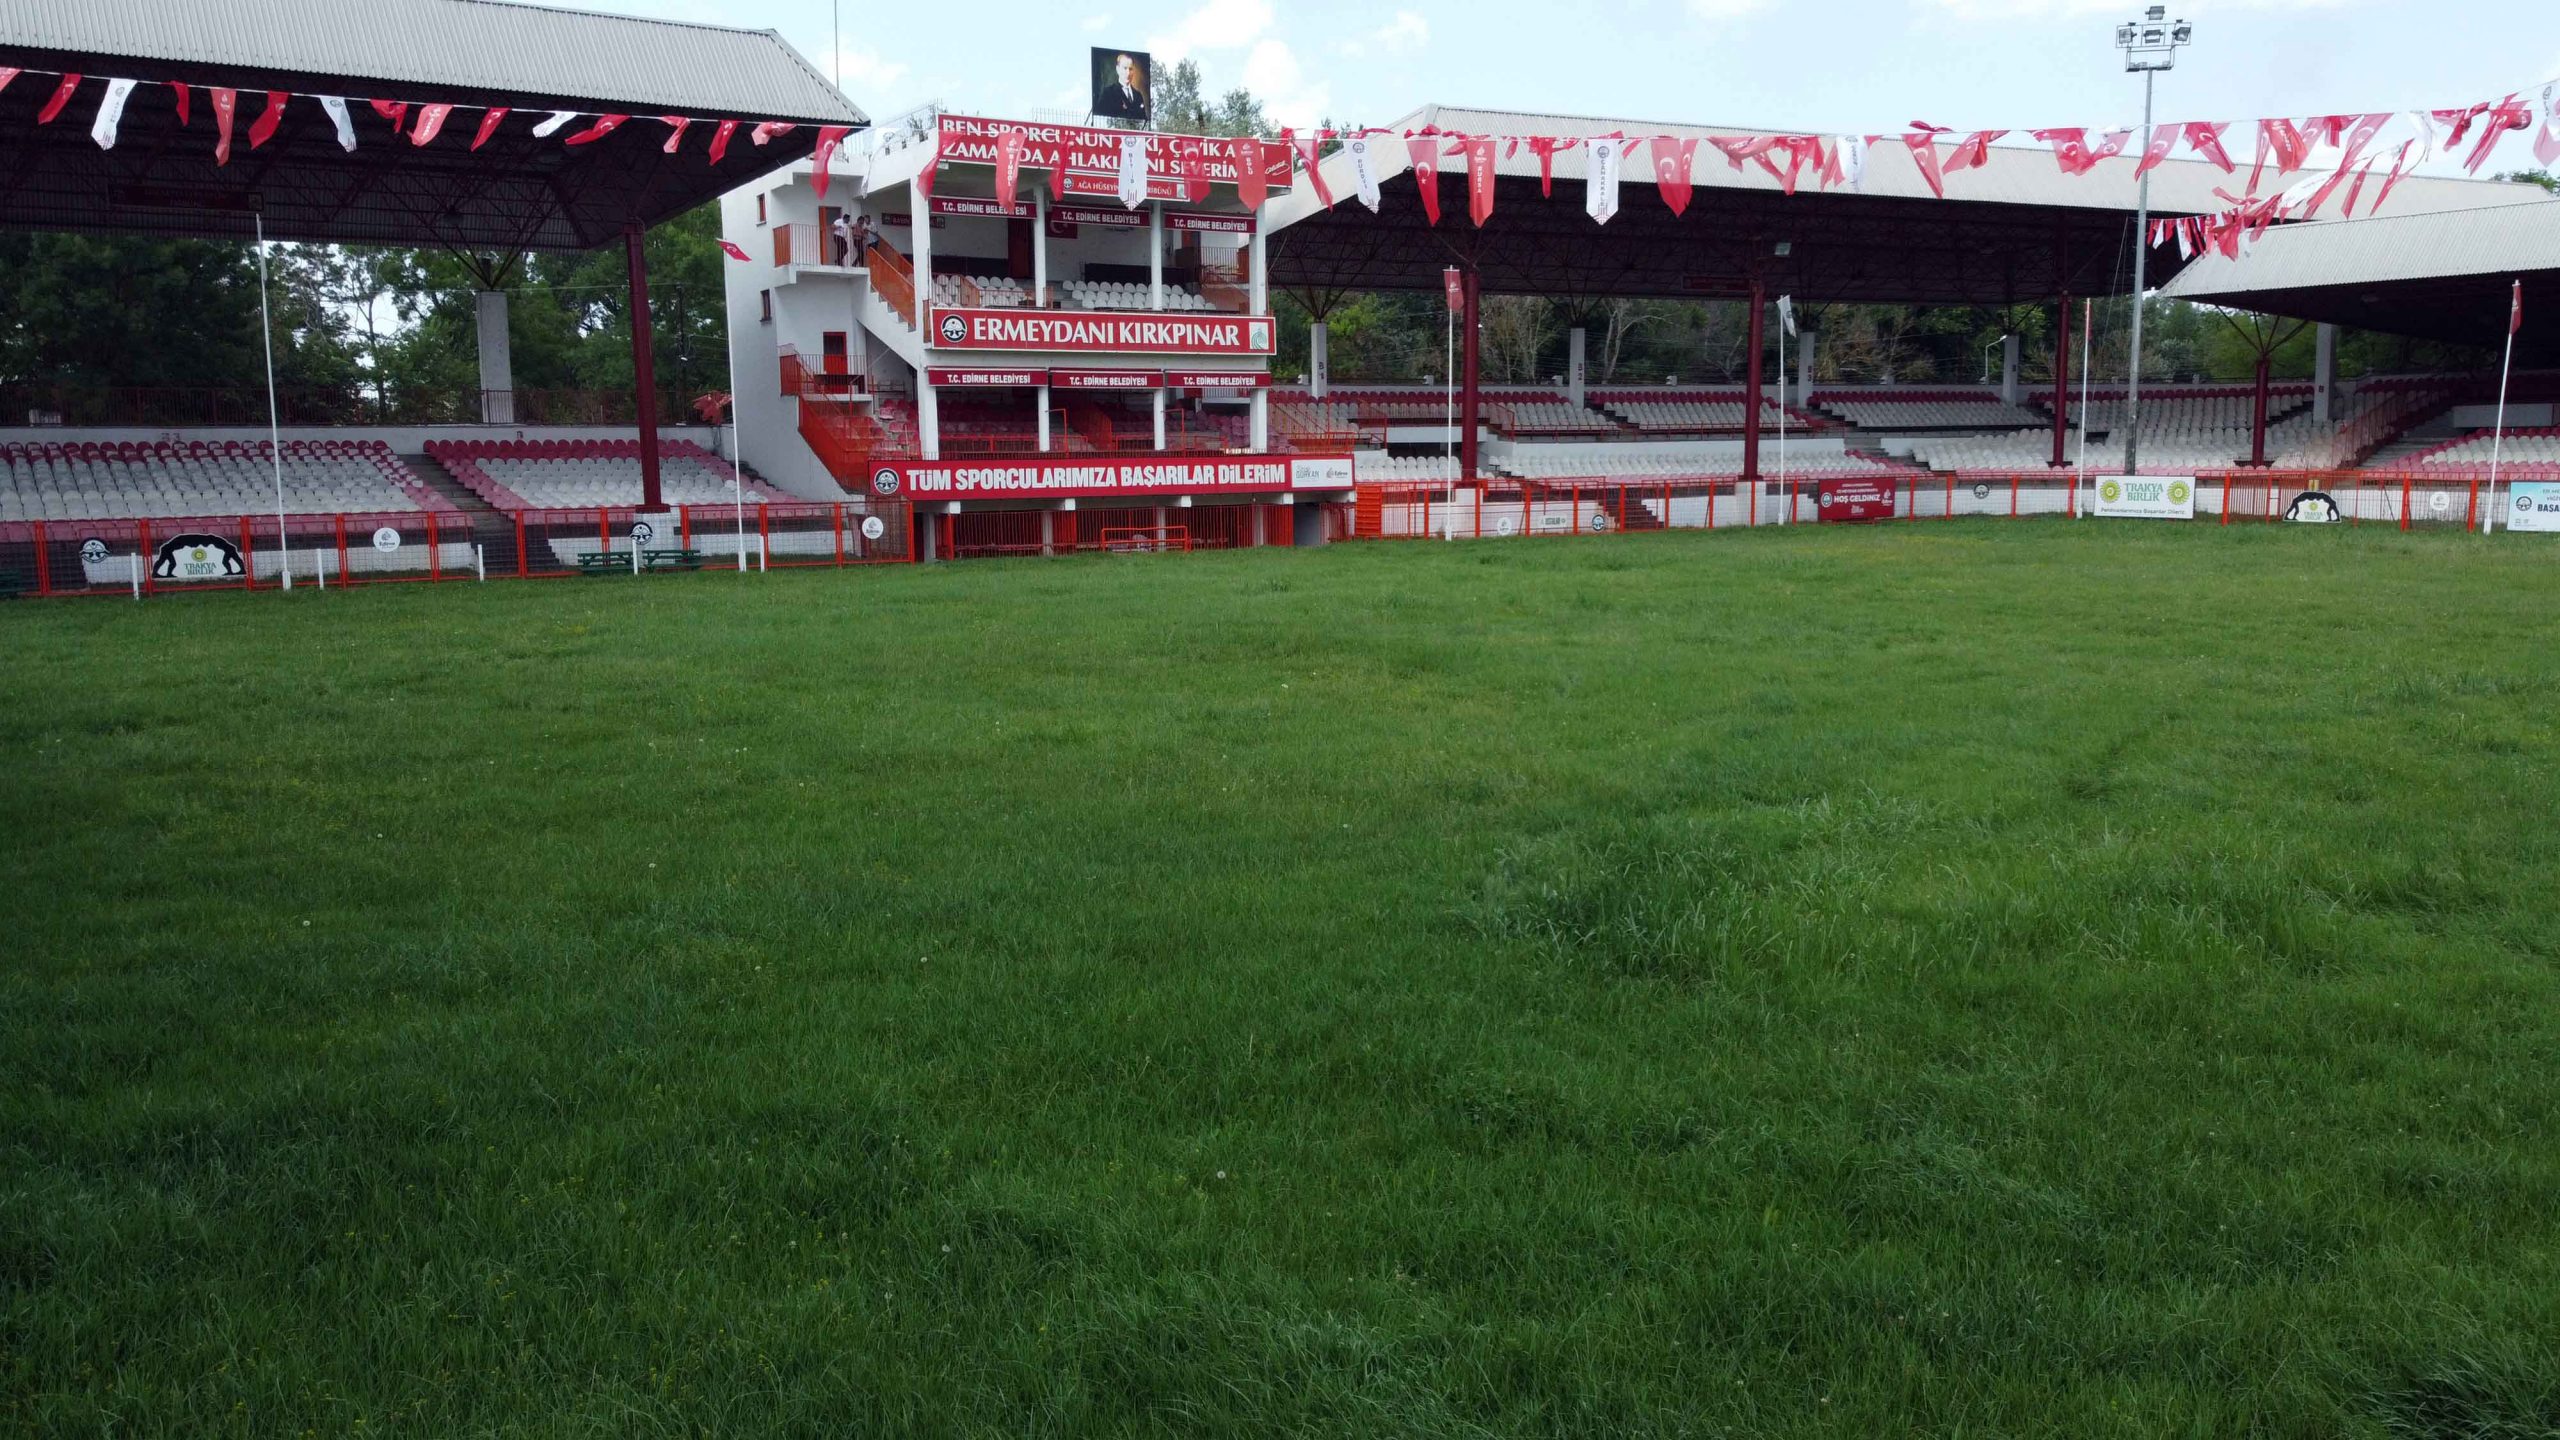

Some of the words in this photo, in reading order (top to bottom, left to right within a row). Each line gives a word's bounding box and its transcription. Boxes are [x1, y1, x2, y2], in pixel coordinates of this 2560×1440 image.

[943, 119, 981, 137] BEN
[943, 142, 1045, 164] ZAMADA
[942, 202, 956, 211] T.C.
[957, 202, 984, 213] EDİRNE
[1075, 212, 1101, 222] EDİRNE
[1101, 213, 1140, 225] BELEDİYESİ
[1174, 218, 1186, 228] T.C.
[1187, 218, 1211, 229] EDİRNE
[1211, 220, 1248, 231] BELEDİYESİ
[973, 317, 1114, 344] ERMEYDANI
[1119, 321, 1241, 346] KIRKPINAR
[947, 374, 960, 383] T.C.
[962, 373, 988, 383] EDİRNE
[989, 373, 1031, 384] BELEDİYESİ
[1069, 376, 1082, 385] T.C.
[1083, 375, 1108, 386] EDİRNE
[1109, 375, 1148, 386] BELEDİYESİ
[1183, 376, 1195, 385] T.C.
[1196, 375, 1219, 386] EDİRNE
[1220, 375, 1256, 386] BELEDİYESİ
[906, 469, 951, 491] TÜM
[955, 467, 1118, 490] SPORCULARIMIZA
[1120, 464, 1214, 488] BAŞARILAR
[1218, 463, 1286, 485] DİLERİM
[2125, 483, 2163, 492] TRAKYA
